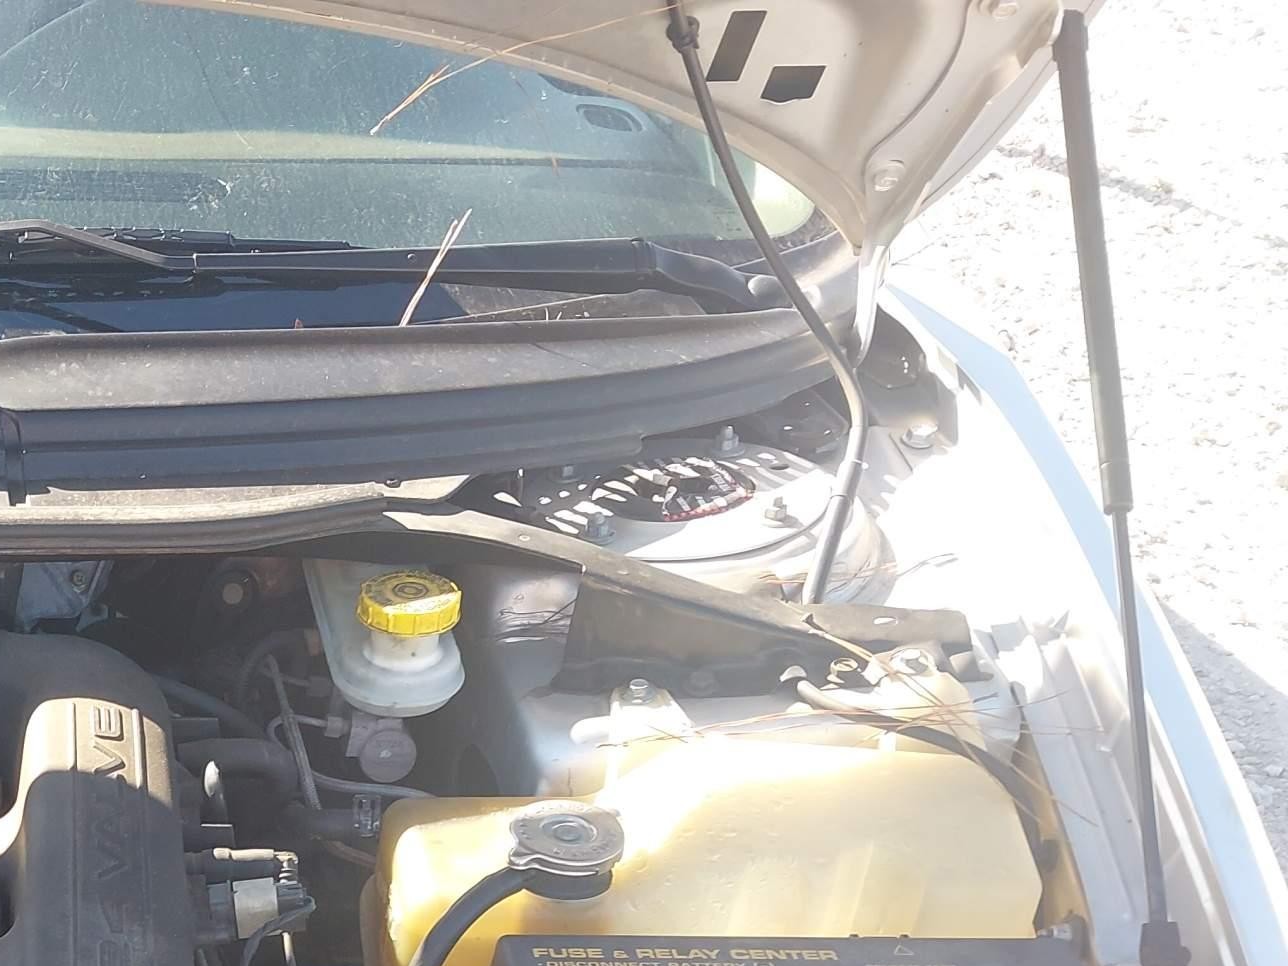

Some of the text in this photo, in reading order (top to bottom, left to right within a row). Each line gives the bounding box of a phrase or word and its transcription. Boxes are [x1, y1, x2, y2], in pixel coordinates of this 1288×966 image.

[92, 704, 127, 880] VALVE
[532, 948, 839, 961] FUSE & RELAY CENTER
